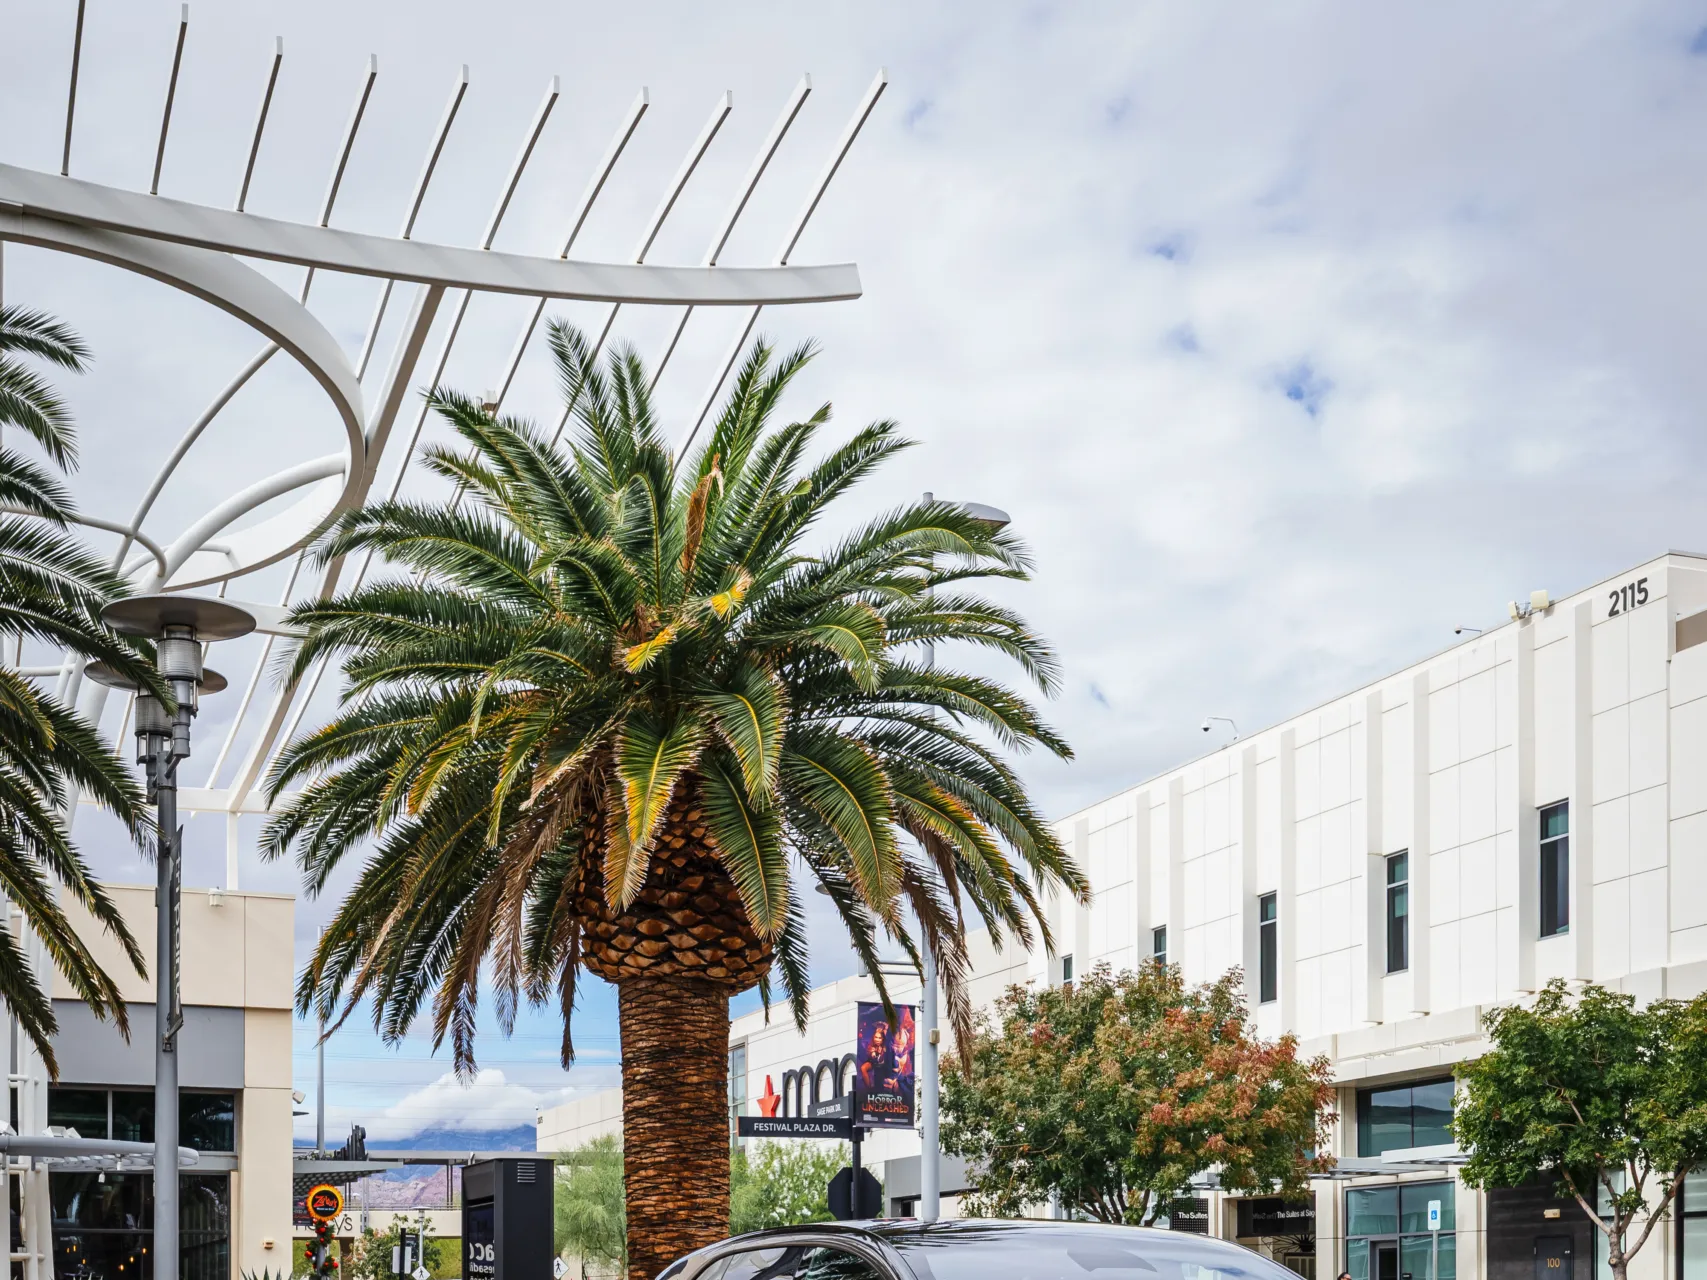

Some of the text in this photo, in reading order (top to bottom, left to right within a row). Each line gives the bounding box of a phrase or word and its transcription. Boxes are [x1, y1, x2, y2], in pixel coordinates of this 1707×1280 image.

[1608, 577, 1649, 618] 2115
[867, 1094, 903, 1104] HORROR
[816, 1106, 826, 1116] SAGE
[825, 1104, 835, 1114] PARK
[862, 1103, 909, 1114] UNLEASHED
[753, 1123, 837, 1132] FESTIVAL PLAZA DR.
[1178, 1211, 1209, 1219] The Suites
[1276, 1211, 1286, 1219] The
[1286, 1210, 1300, 1218] Suites
[1305, 1209, 1316, 1218] Sag
[1547, 1258, 1560, 1268] 100
